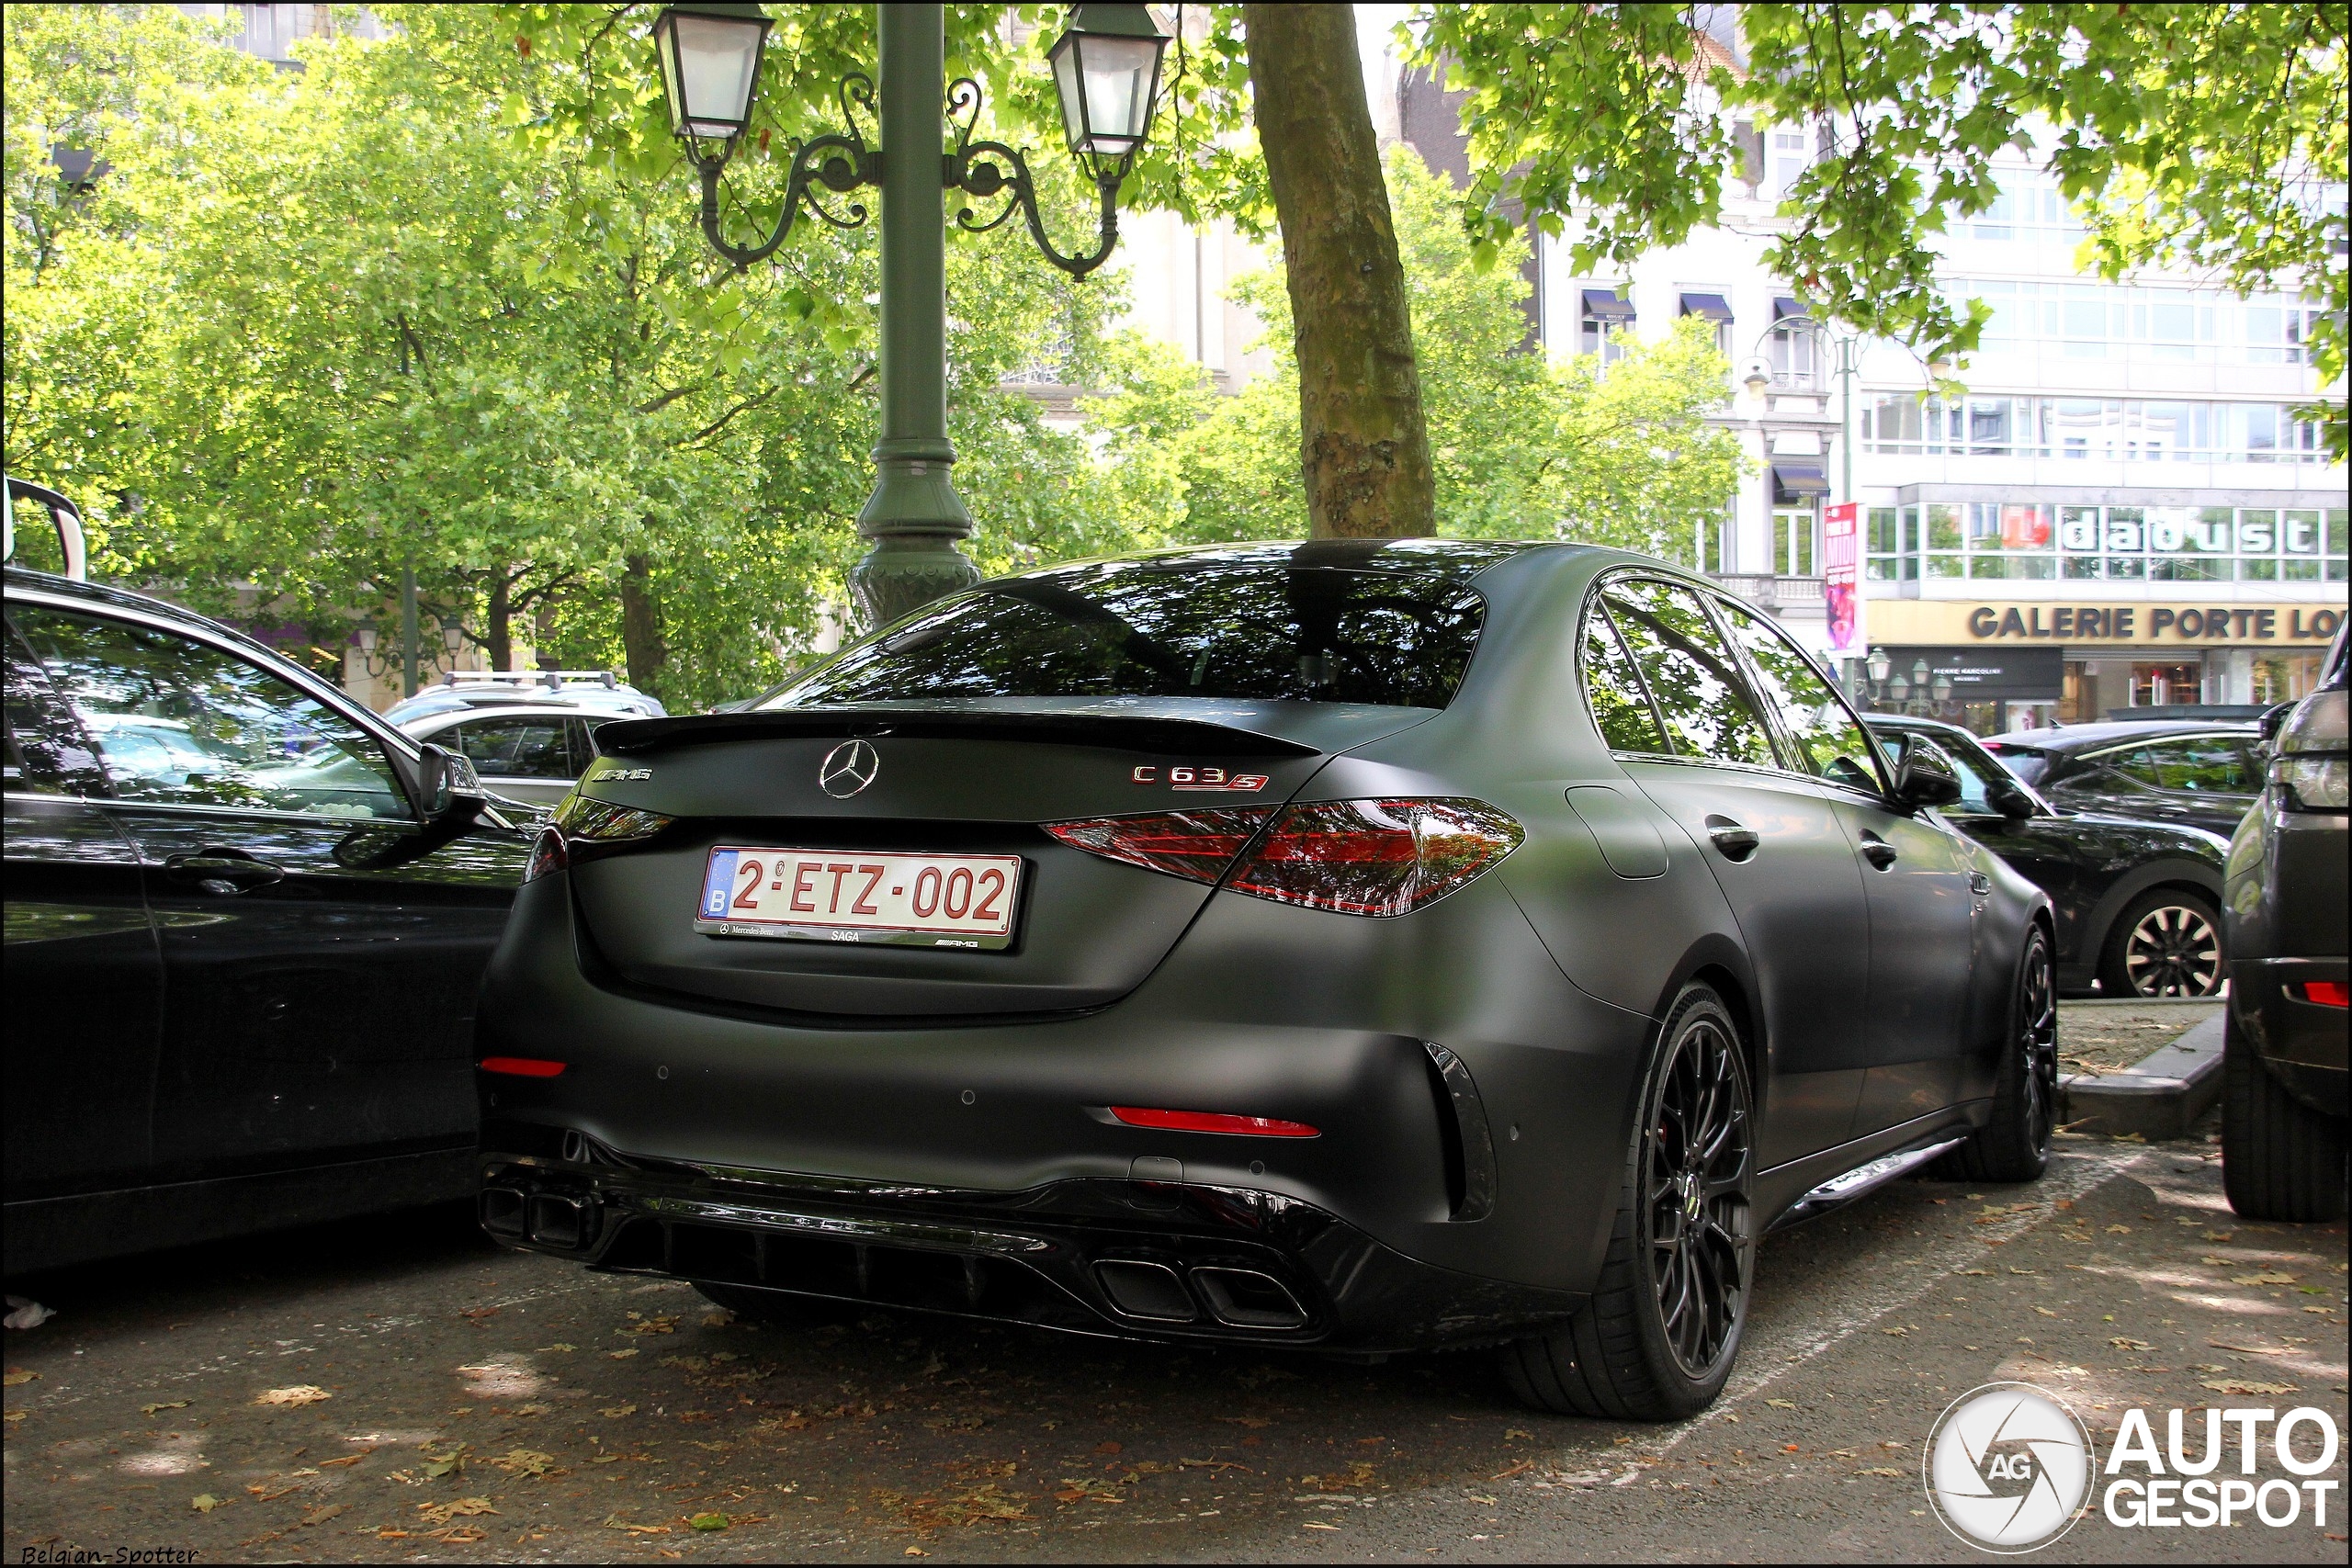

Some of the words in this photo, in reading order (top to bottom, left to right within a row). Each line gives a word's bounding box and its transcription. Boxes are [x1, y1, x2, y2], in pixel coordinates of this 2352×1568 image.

[2063, 512, 2311, 551] daoust
[1826, 535, 1855, 567] MIDI
[1969, 607, 2133, 638] GALERIE
[2152, 608, 2275, 639] PORTE
[598, 769, 653, 781] AMG
[1133, 766, 1156, 784] C
[709, 890, 726, 912] B
[731, 925, 775, 936] Mercedes-Benz
[831, 931, 860, 942] SAGA
[944, 940, 978, 948] AMG
